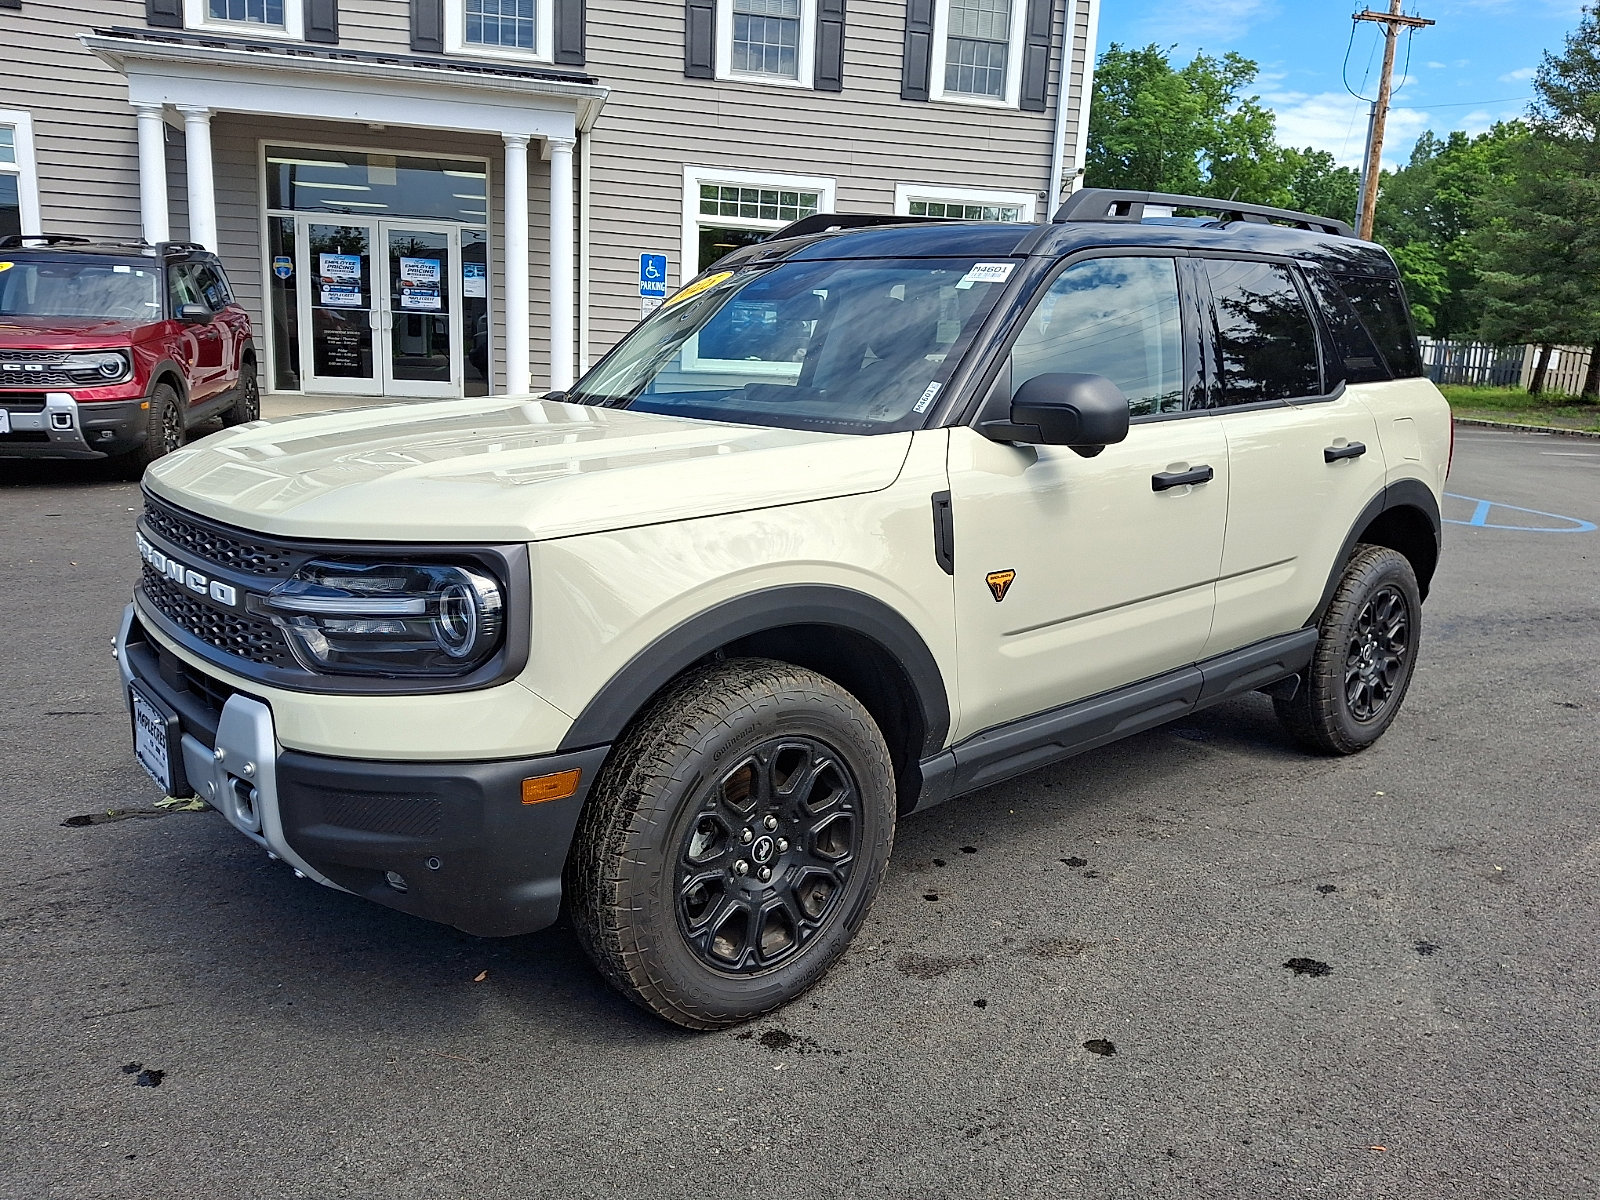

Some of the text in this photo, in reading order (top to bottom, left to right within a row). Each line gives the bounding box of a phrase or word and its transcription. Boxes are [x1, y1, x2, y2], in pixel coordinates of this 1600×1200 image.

[640, 280, 665, 292] PARKING
[914, 389, 935, 412] M4601
[137, 708, 167, 749] MAPLECRES
[713, 723, 756, 762] Continental
